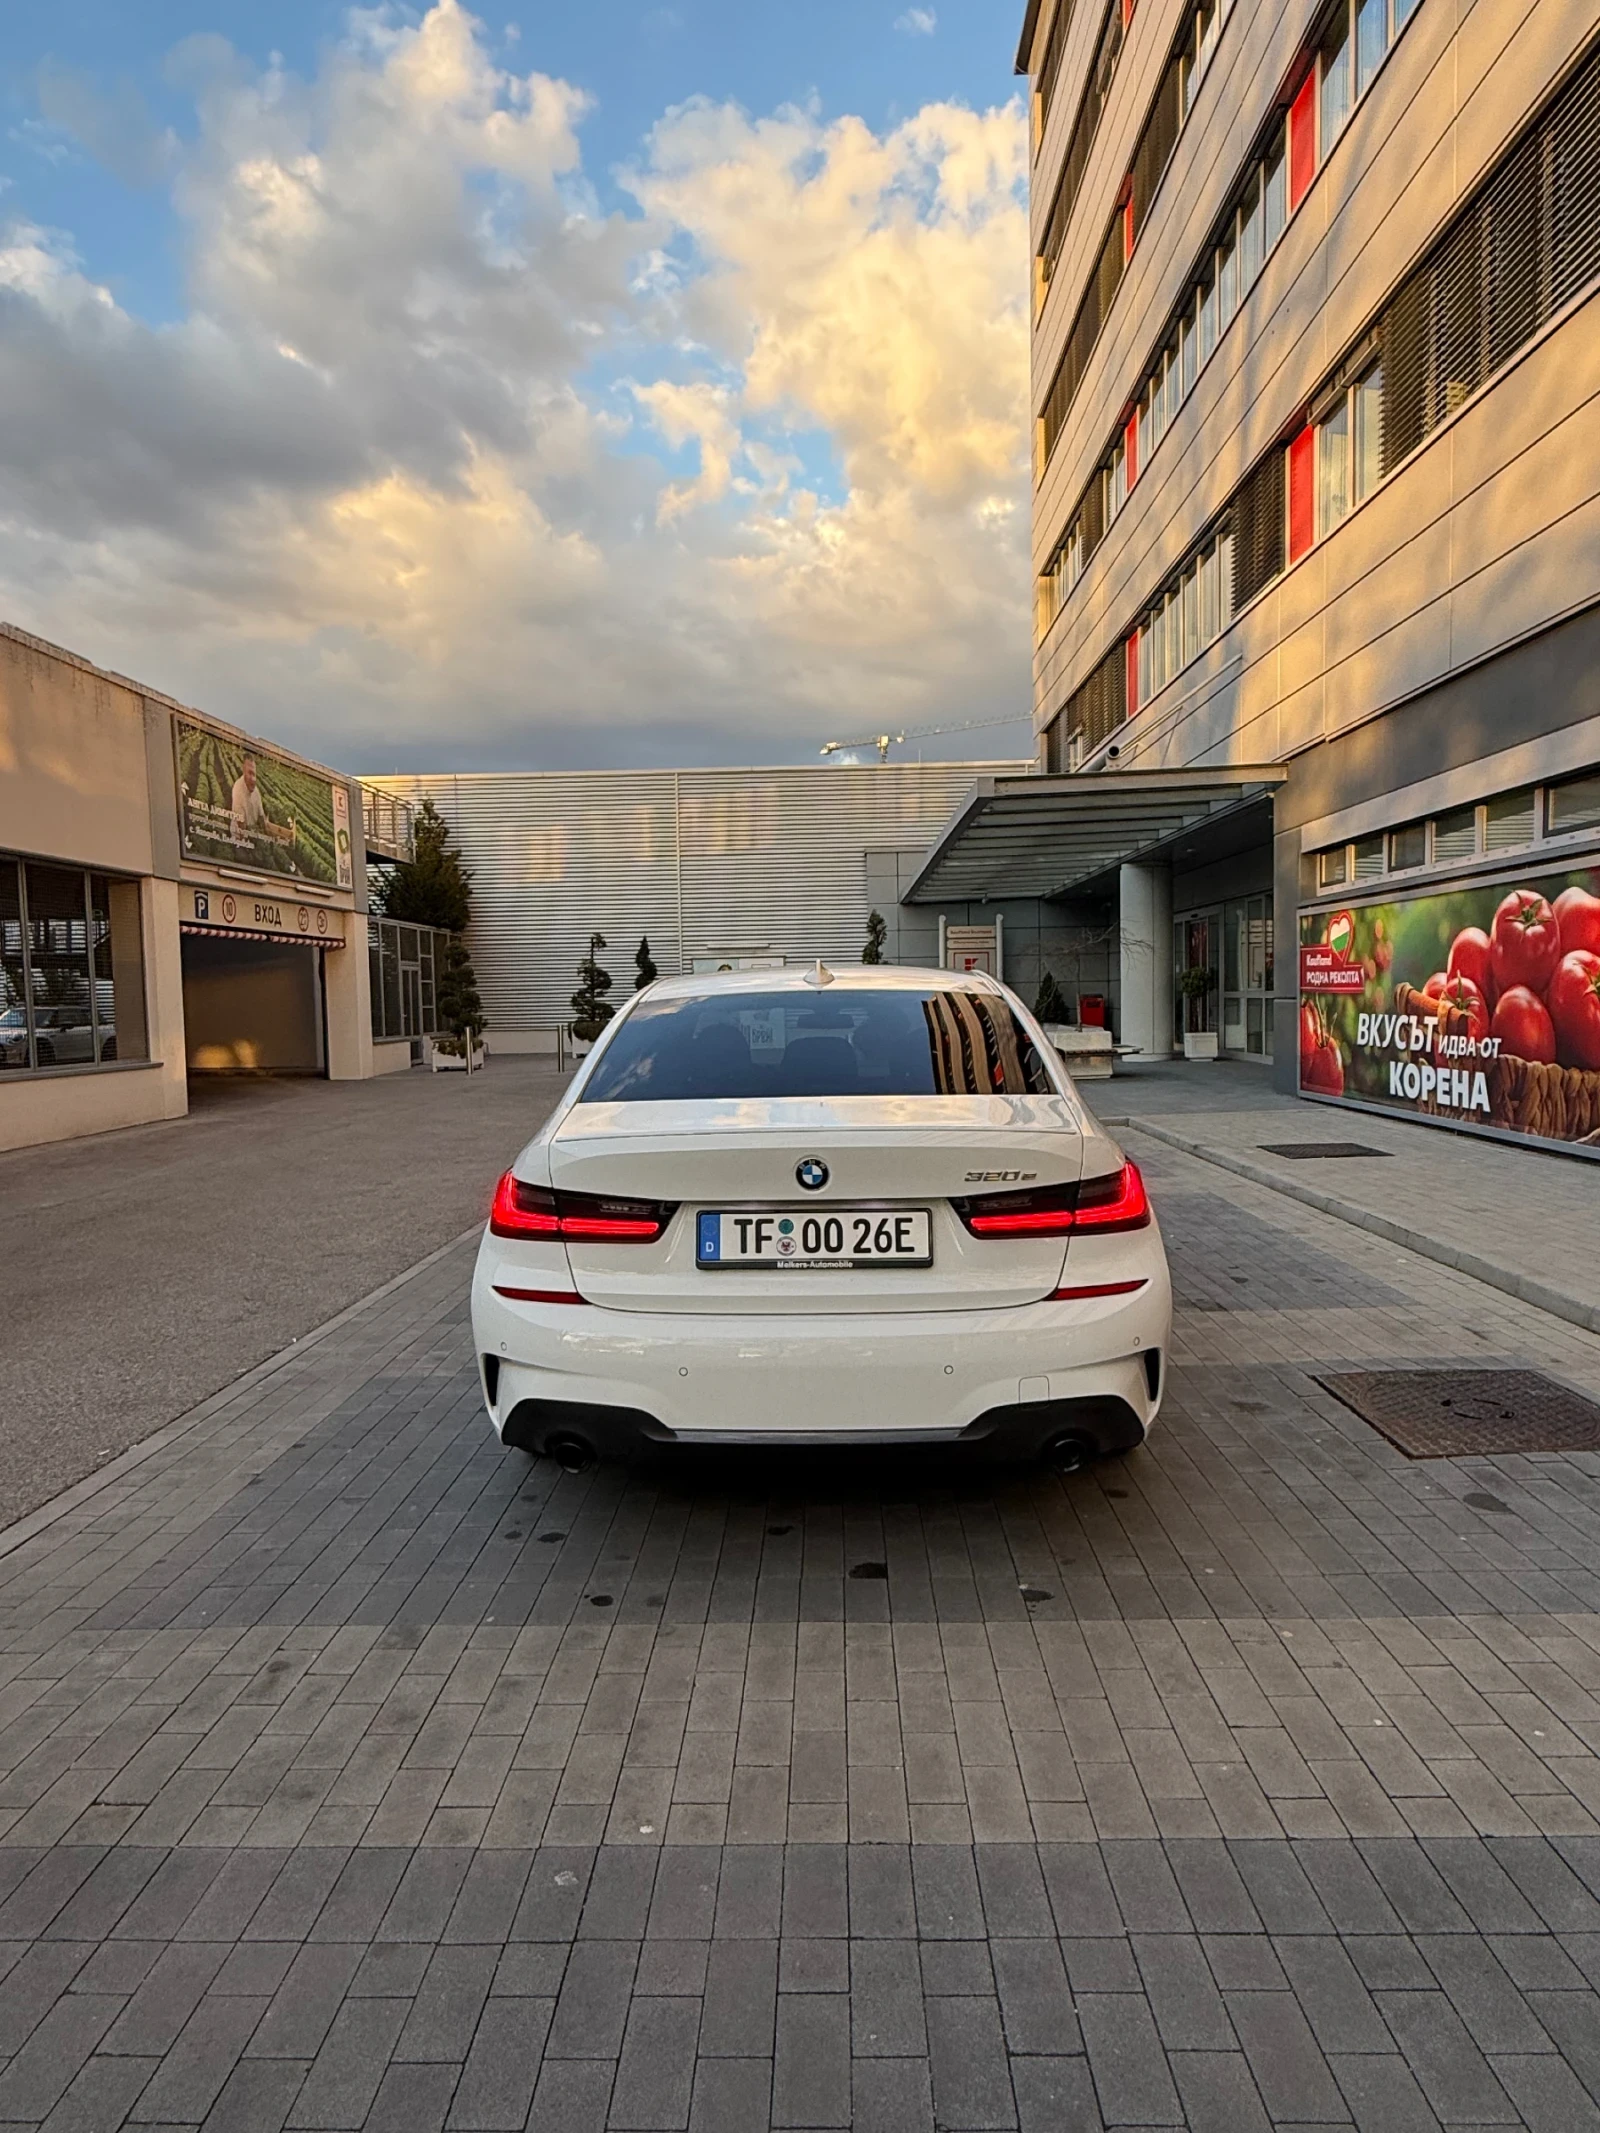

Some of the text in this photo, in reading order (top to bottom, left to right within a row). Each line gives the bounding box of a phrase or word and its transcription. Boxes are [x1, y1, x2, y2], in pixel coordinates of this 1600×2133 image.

[254, 903, 282, 928] ВХОД
[1306, 971, 1360, 986] РОДНА РЕКОЛТА
[1356, 1013, 1502, 1059] ВКУСЪТ ИДВА ОТ
[1389, 1061, 1492, 1113] КОРЕНА
[964, 1170, 1037, 1182] 320e
[705, 1242, 714, 1252] D
[734, 1218, 774, 1253] TF
[853, 1217, 915, 1254] 26E
